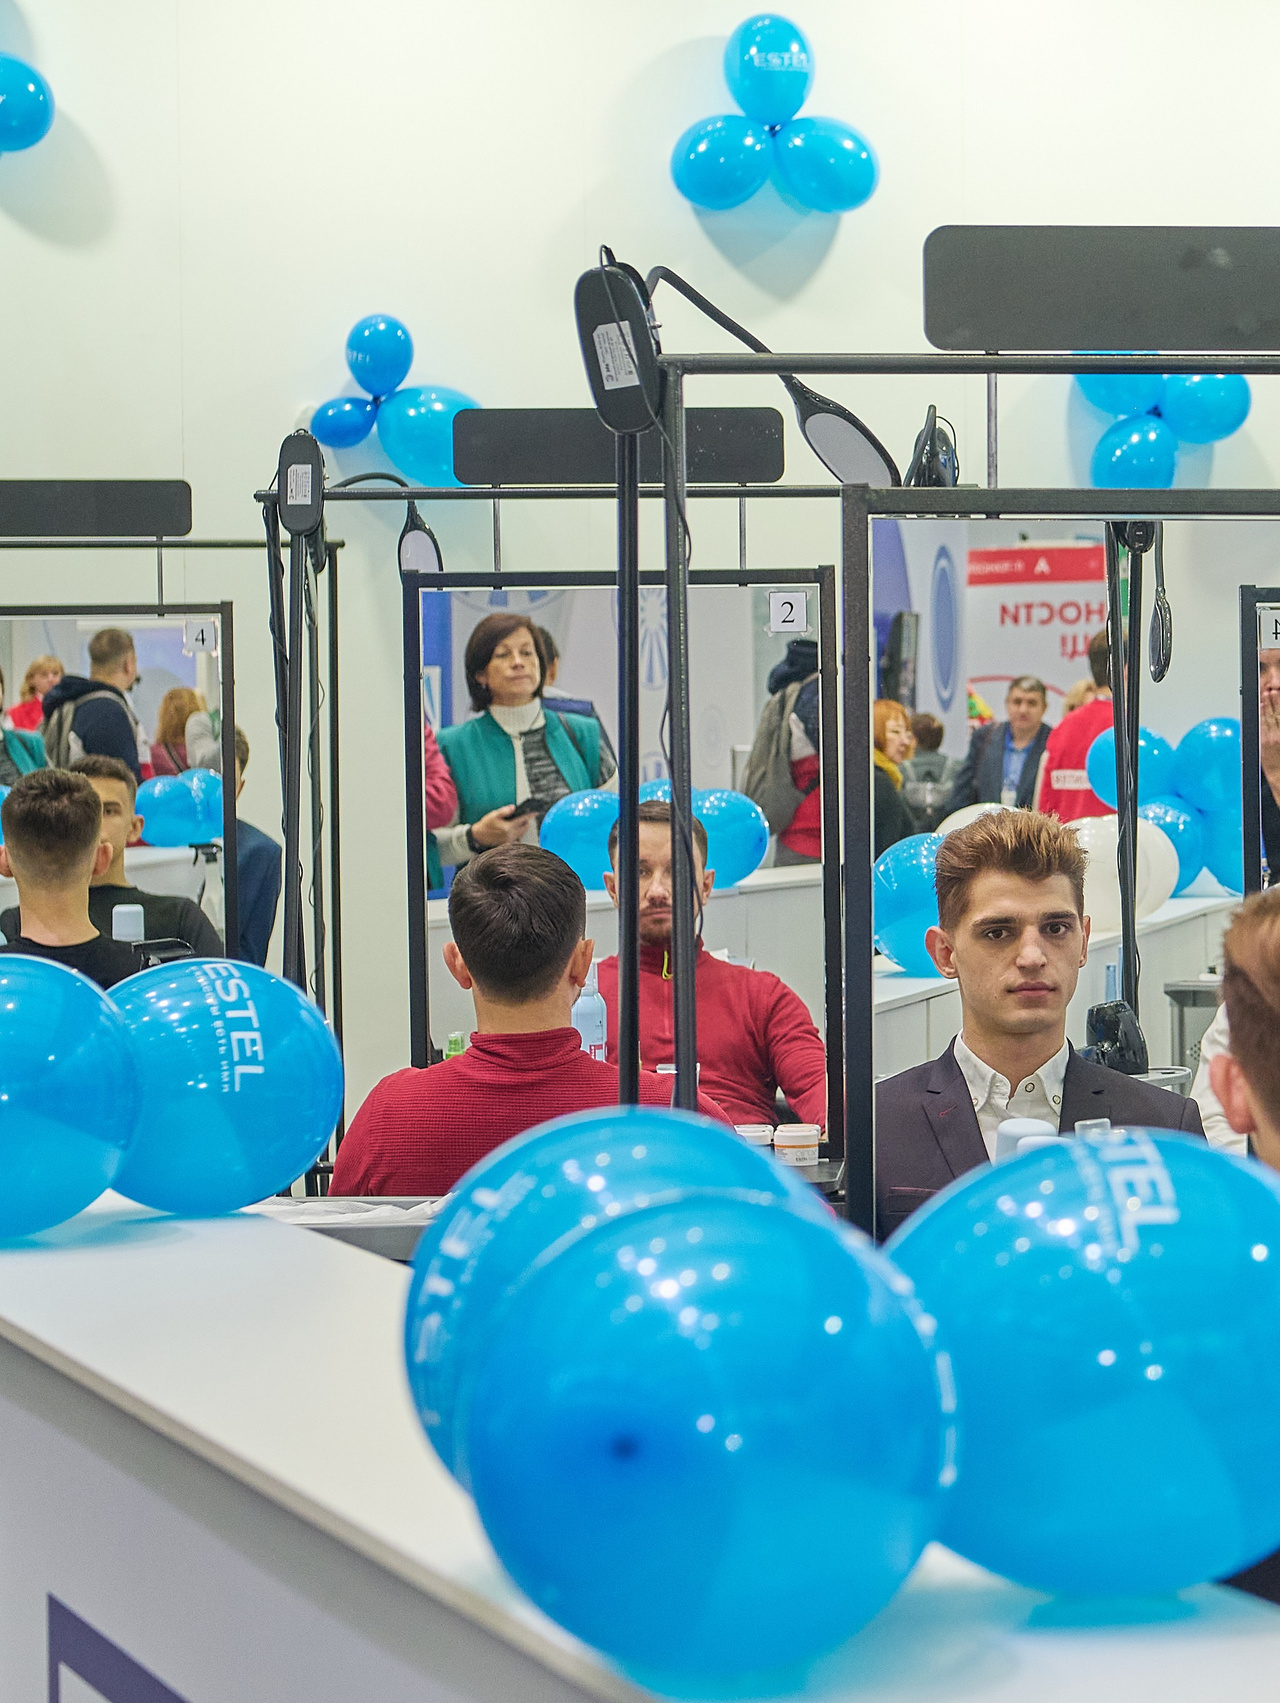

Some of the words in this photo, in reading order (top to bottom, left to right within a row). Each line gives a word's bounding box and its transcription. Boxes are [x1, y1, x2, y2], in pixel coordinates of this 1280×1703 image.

[781, 601, 795, 623] 2
[195, 629, 207, 645] 4
[202, 963, 265, 1092] ESTEL
